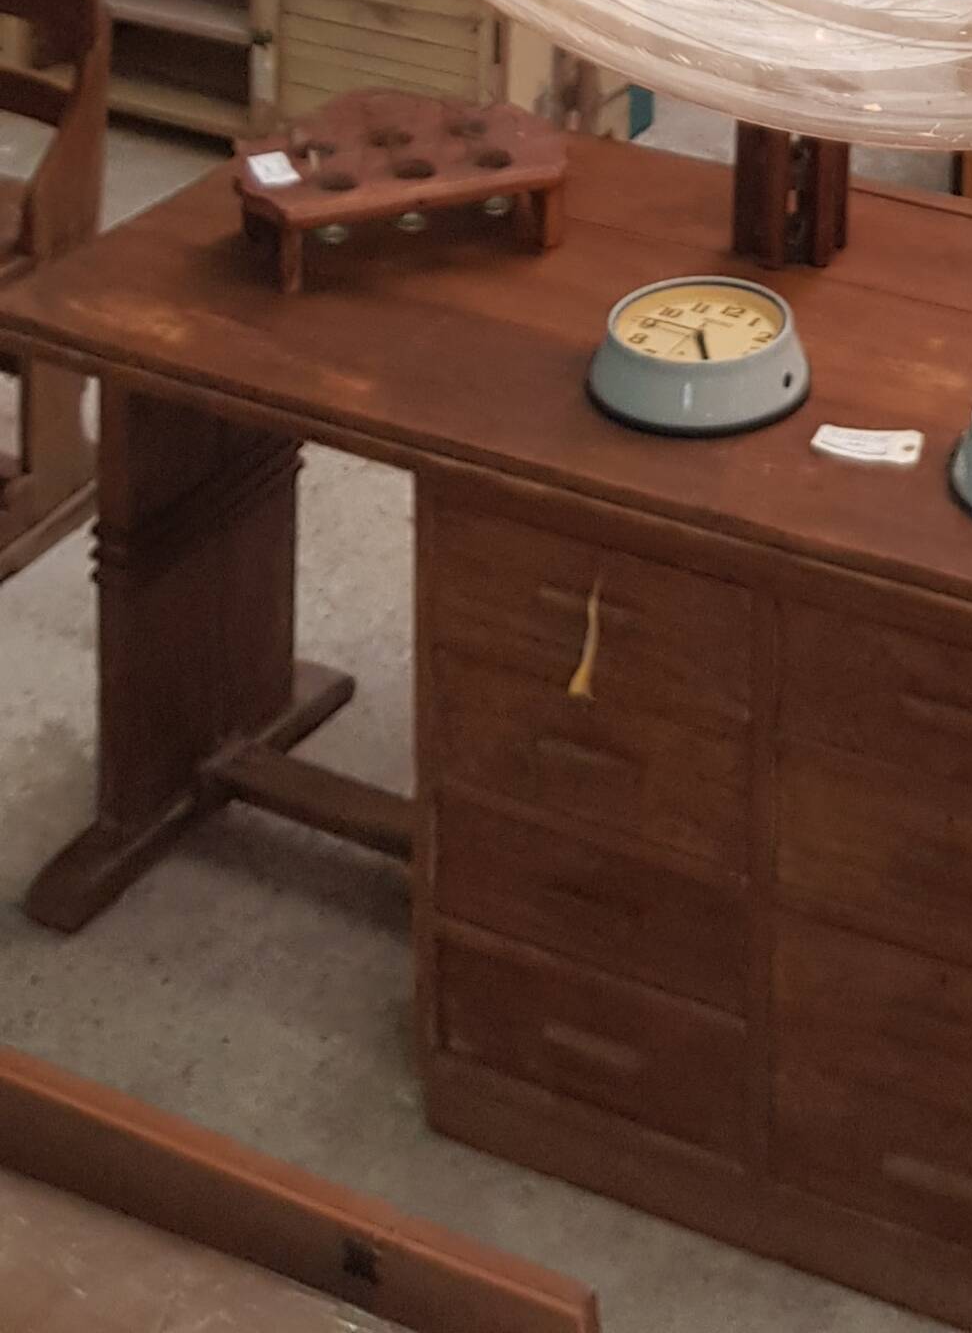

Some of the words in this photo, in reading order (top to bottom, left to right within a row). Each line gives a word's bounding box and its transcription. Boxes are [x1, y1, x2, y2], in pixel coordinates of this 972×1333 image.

[658, 307, 684, 319] 10
[721, 305, 747, 318] 12
[628, 333, 649, 345] 8
[752, 331, 773, 343] 2
